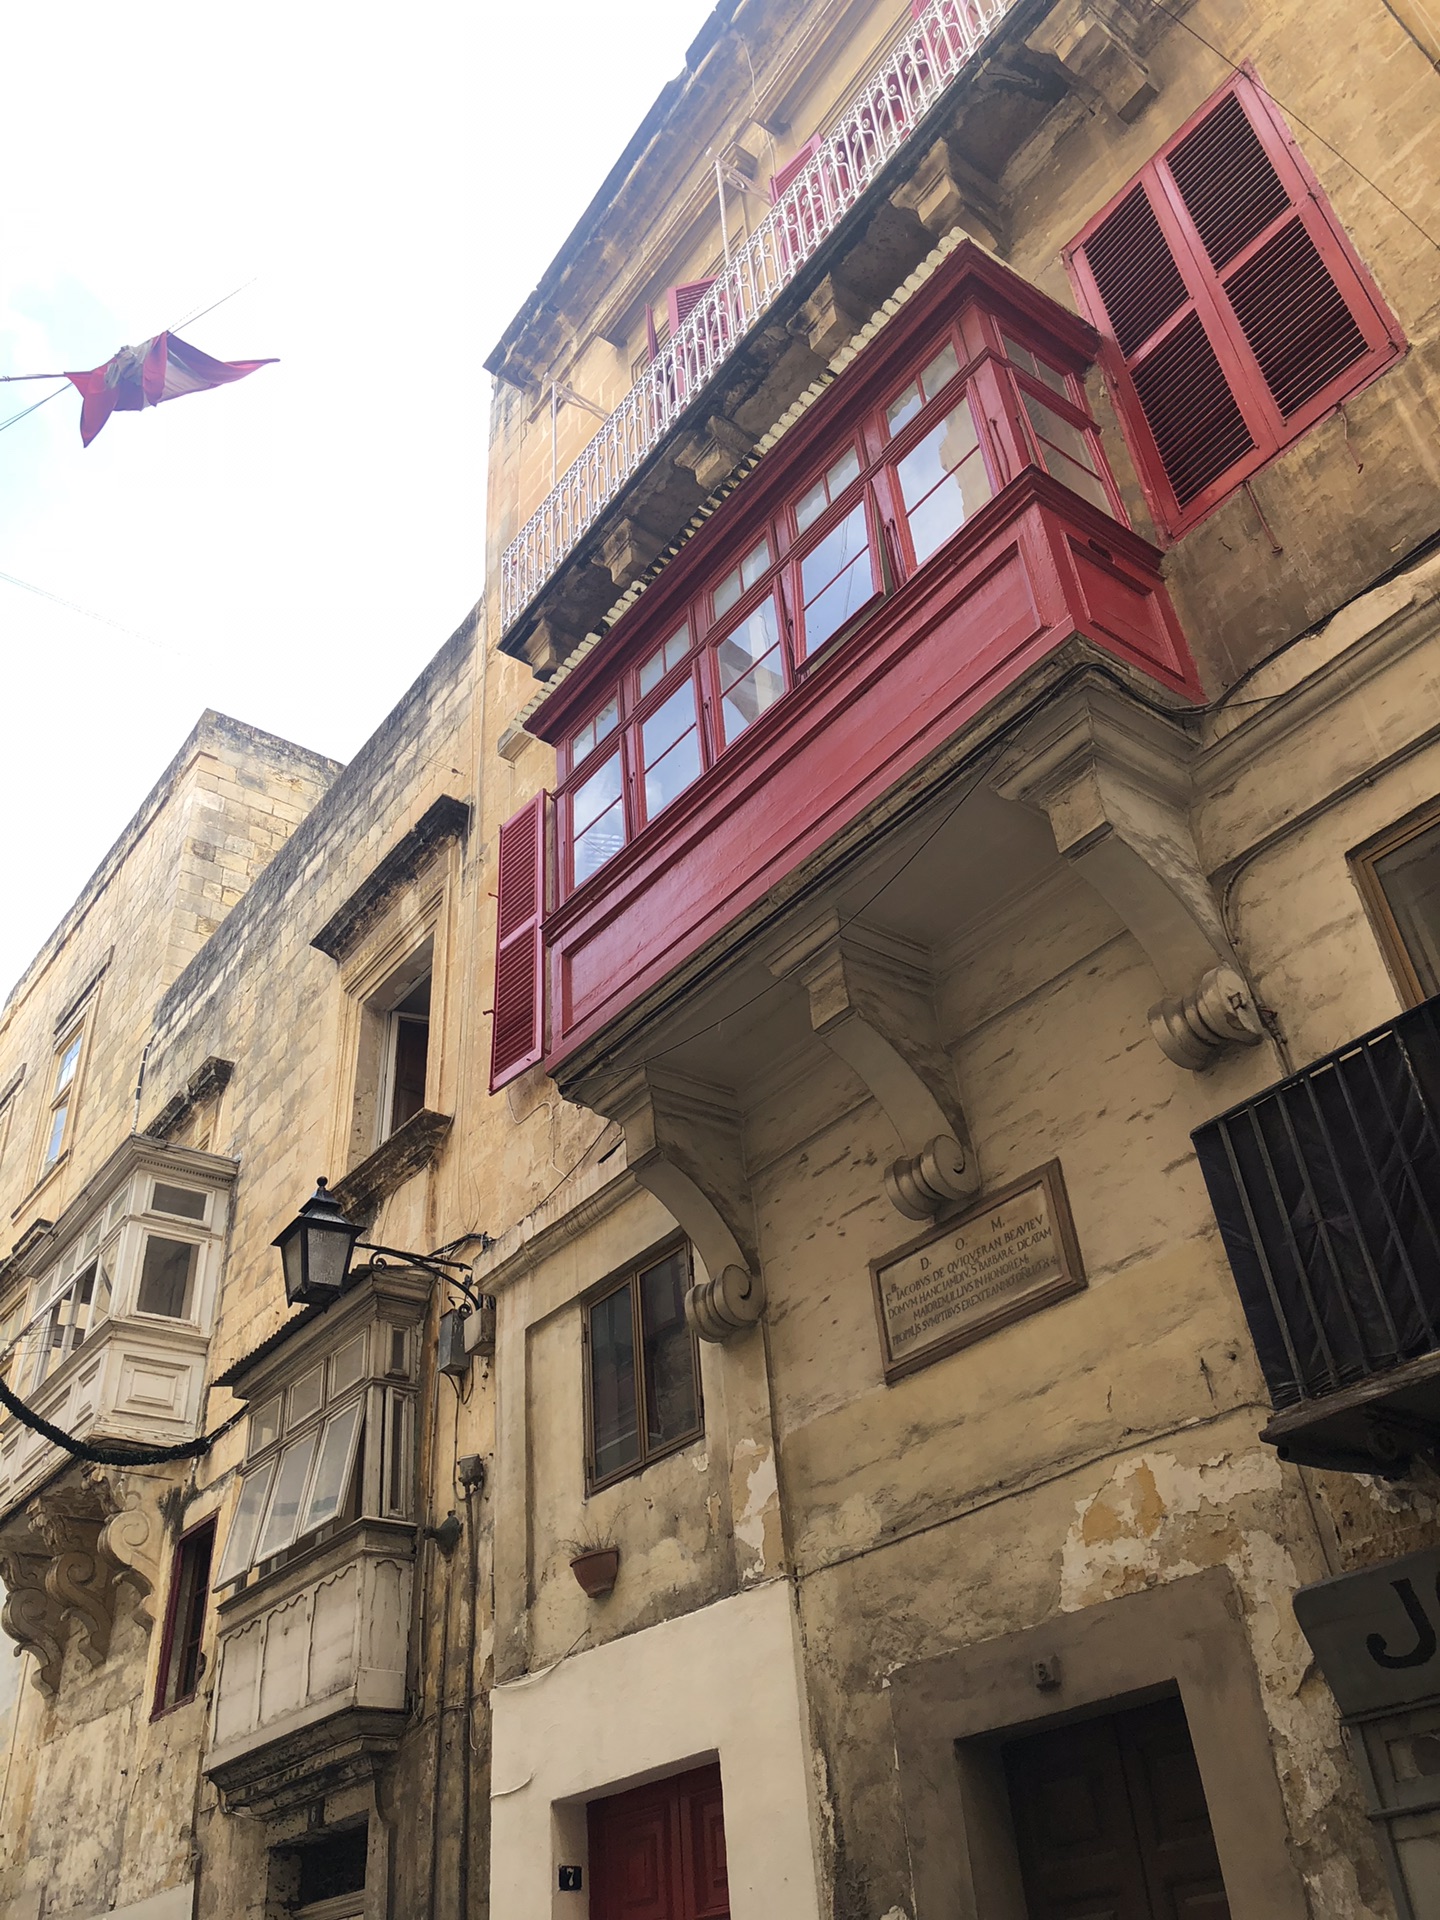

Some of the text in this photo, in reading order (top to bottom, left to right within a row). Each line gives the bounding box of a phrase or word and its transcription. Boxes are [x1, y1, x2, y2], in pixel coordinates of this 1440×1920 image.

[932, 1267, 945, 1282] DE
[887, 1296, 918, 1320] DOMVM
[919, 1283, 942, 1304] HANC
[566, 1867, 575, 1887] 7
